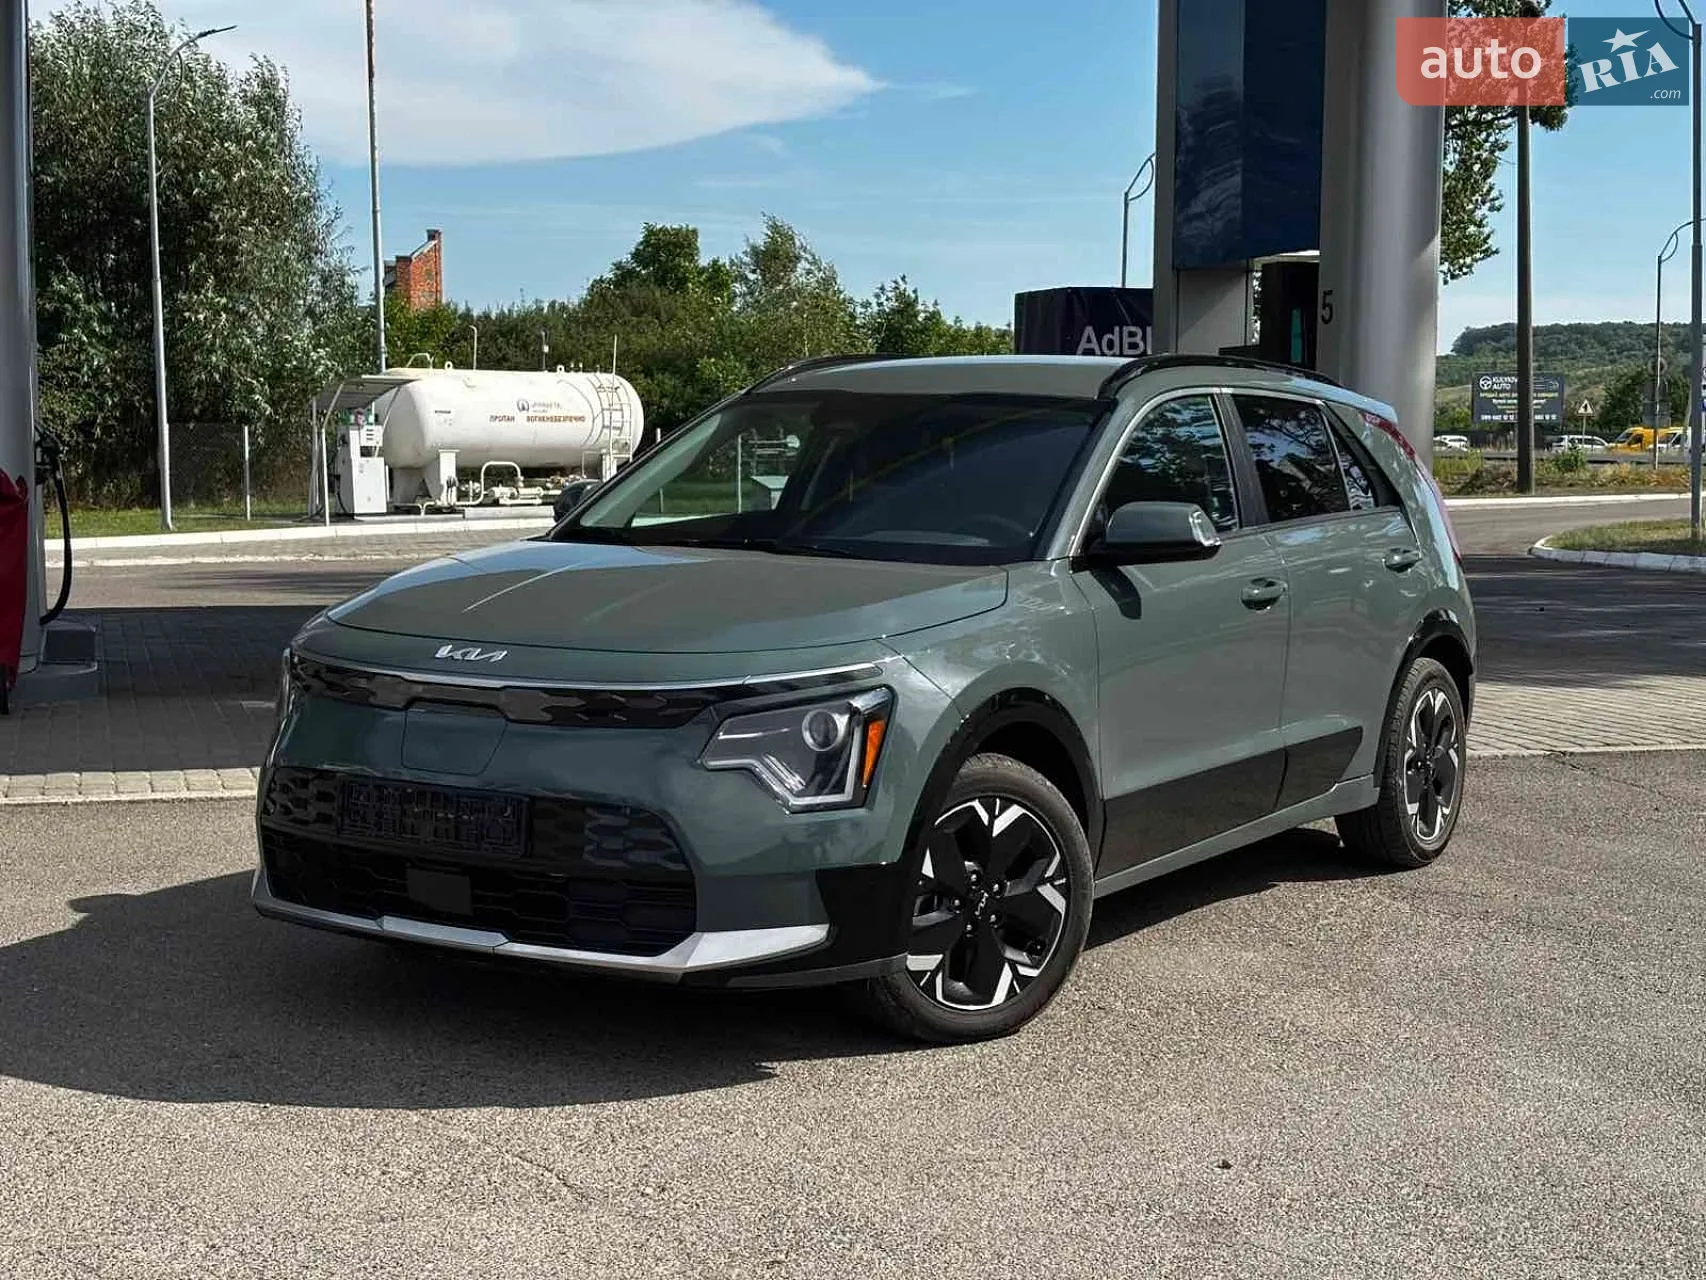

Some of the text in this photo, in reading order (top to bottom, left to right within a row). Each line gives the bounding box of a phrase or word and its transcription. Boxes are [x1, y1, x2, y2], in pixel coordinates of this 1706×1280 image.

[1321, 290, 1334, 324] 5
[1076, 326, 1153, 355] AdBl
[489, 415, 515, 423] ПРОПАН
[435, 644, 508, 662] KIA
